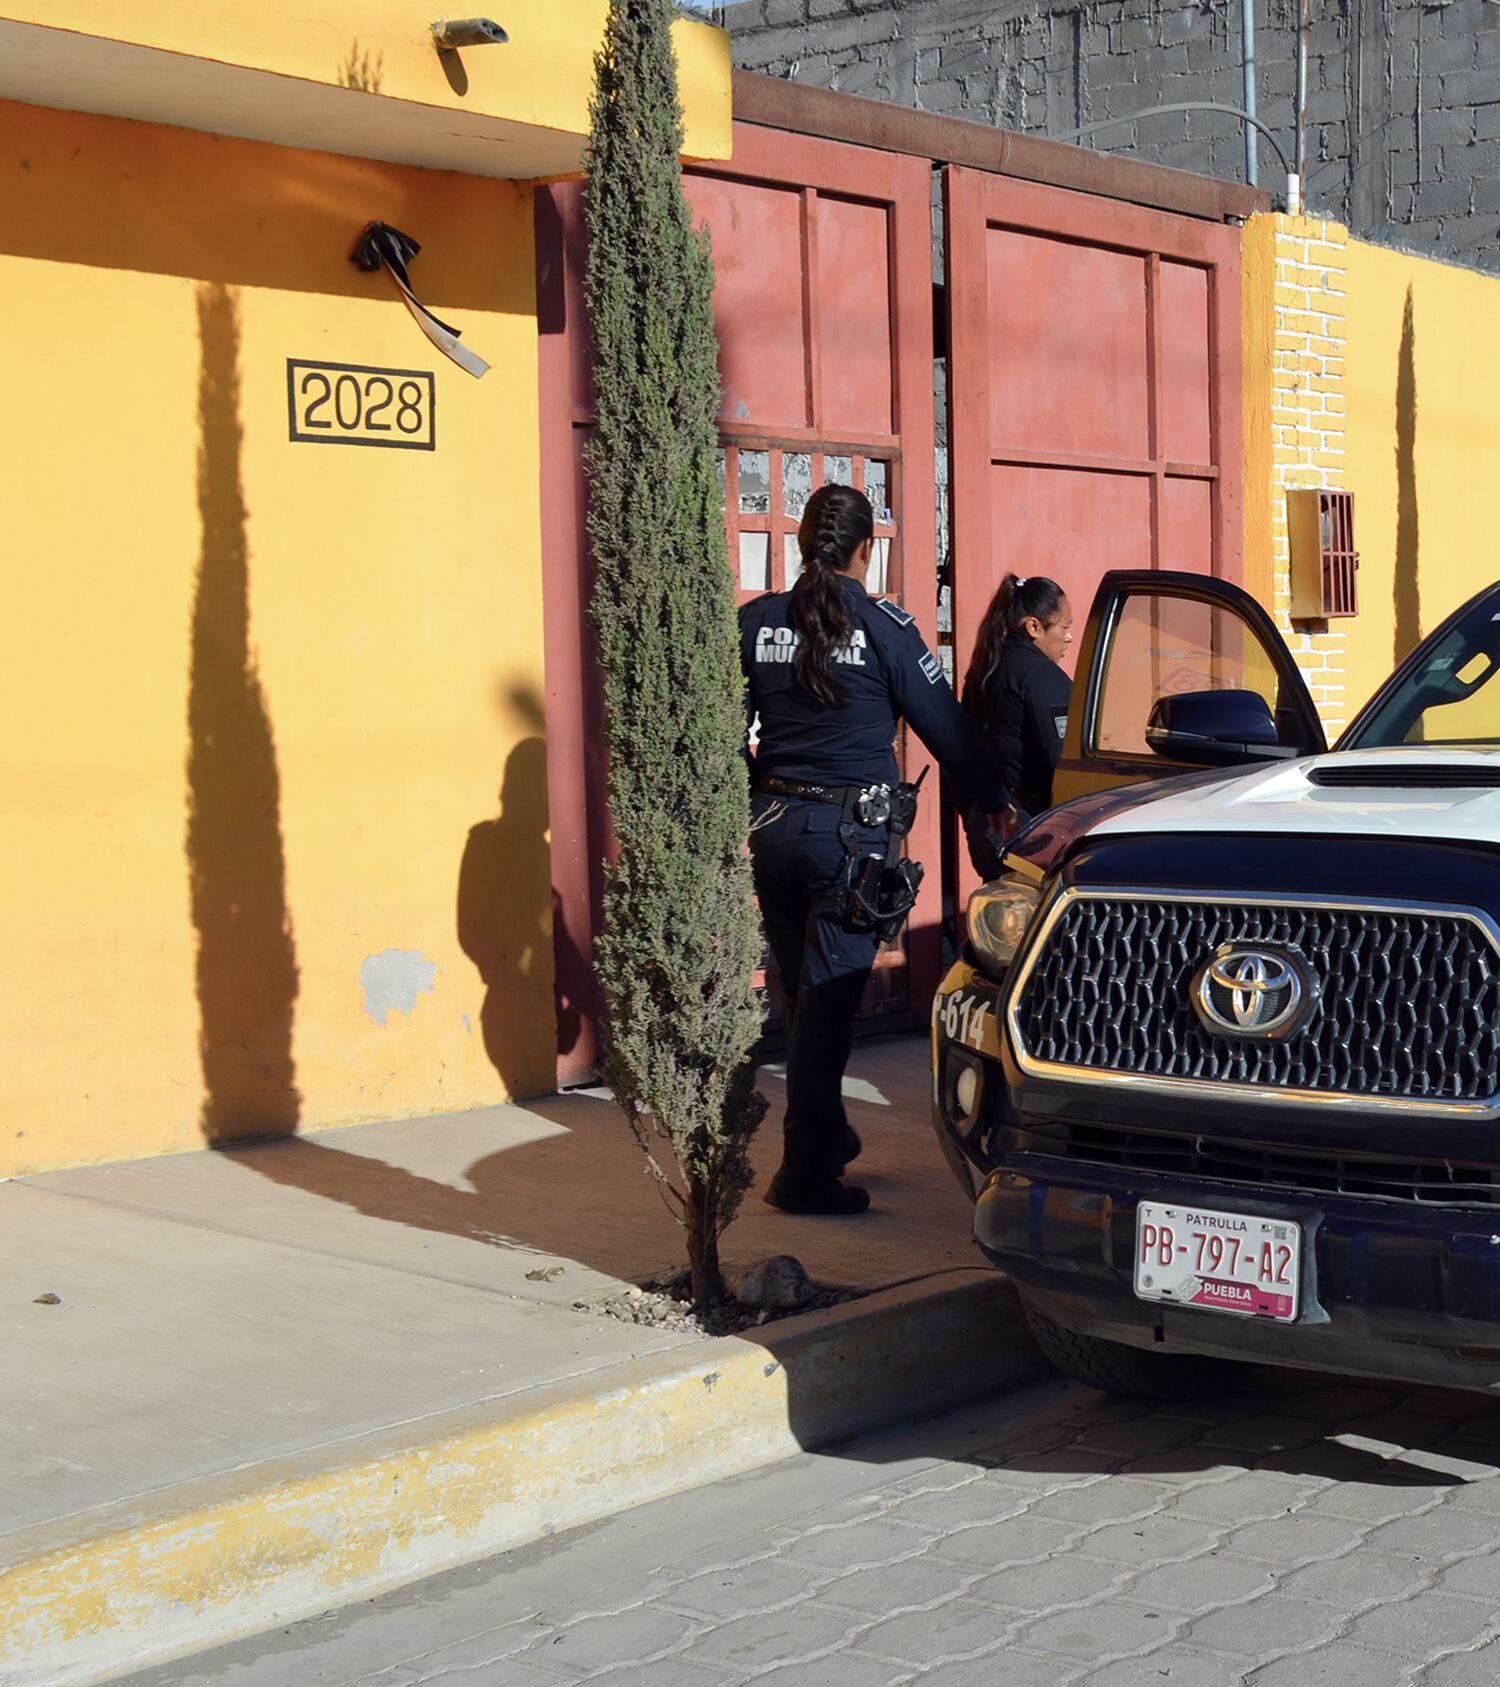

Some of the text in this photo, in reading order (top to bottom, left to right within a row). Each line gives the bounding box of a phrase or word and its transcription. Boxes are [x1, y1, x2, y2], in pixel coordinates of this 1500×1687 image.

[301, 372, 422, 434] 2028
[1186, 1213, 1248, 1232] PATRULLA
[1141, 1224, 1293, 1285] PB-797-A2
[1203, 1283, 1252, 1300] PUEBLA
